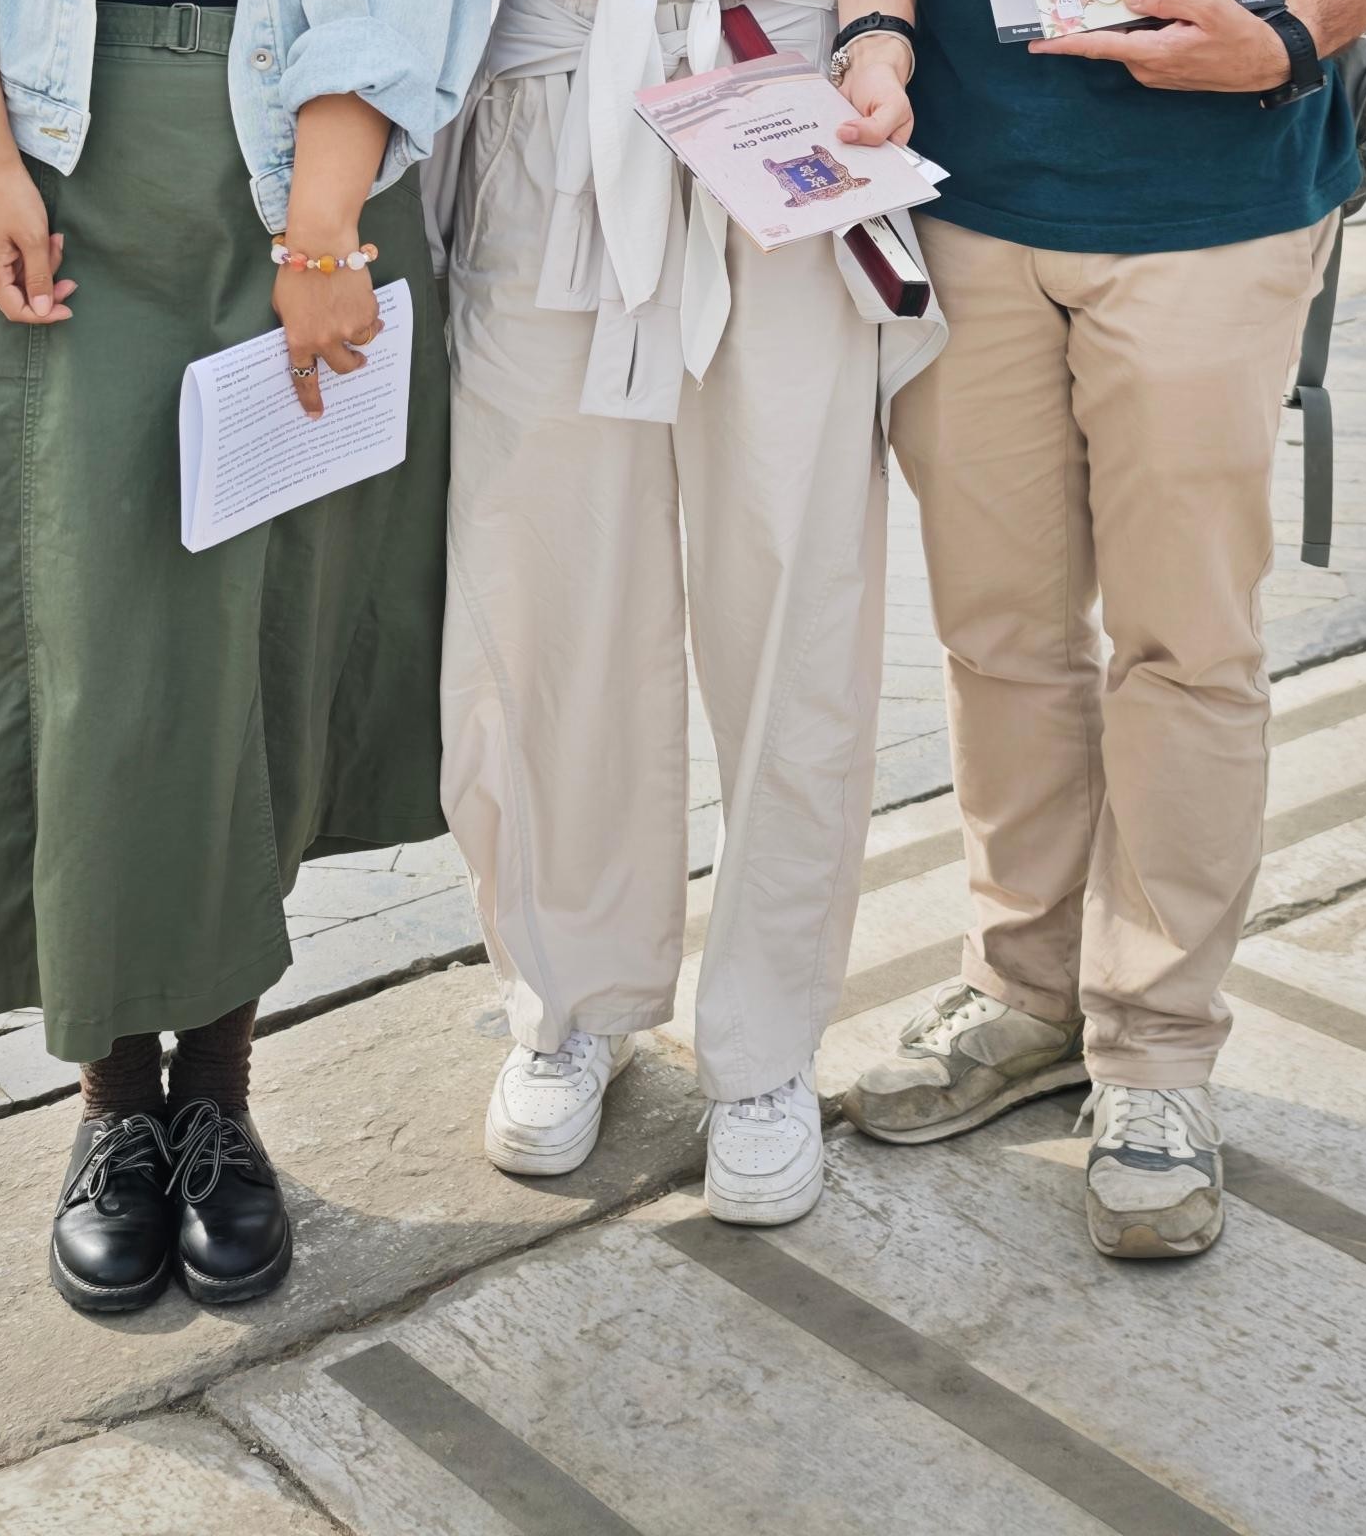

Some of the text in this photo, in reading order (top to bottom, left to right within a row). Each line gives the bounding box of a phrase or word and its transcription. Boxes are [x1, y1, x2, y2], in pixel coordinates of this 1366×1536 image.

[732, 121, 819, 150] Forbidden City
[743, 118, 792, 136] Decoder
[799, 165, 828, 188] 故宫
